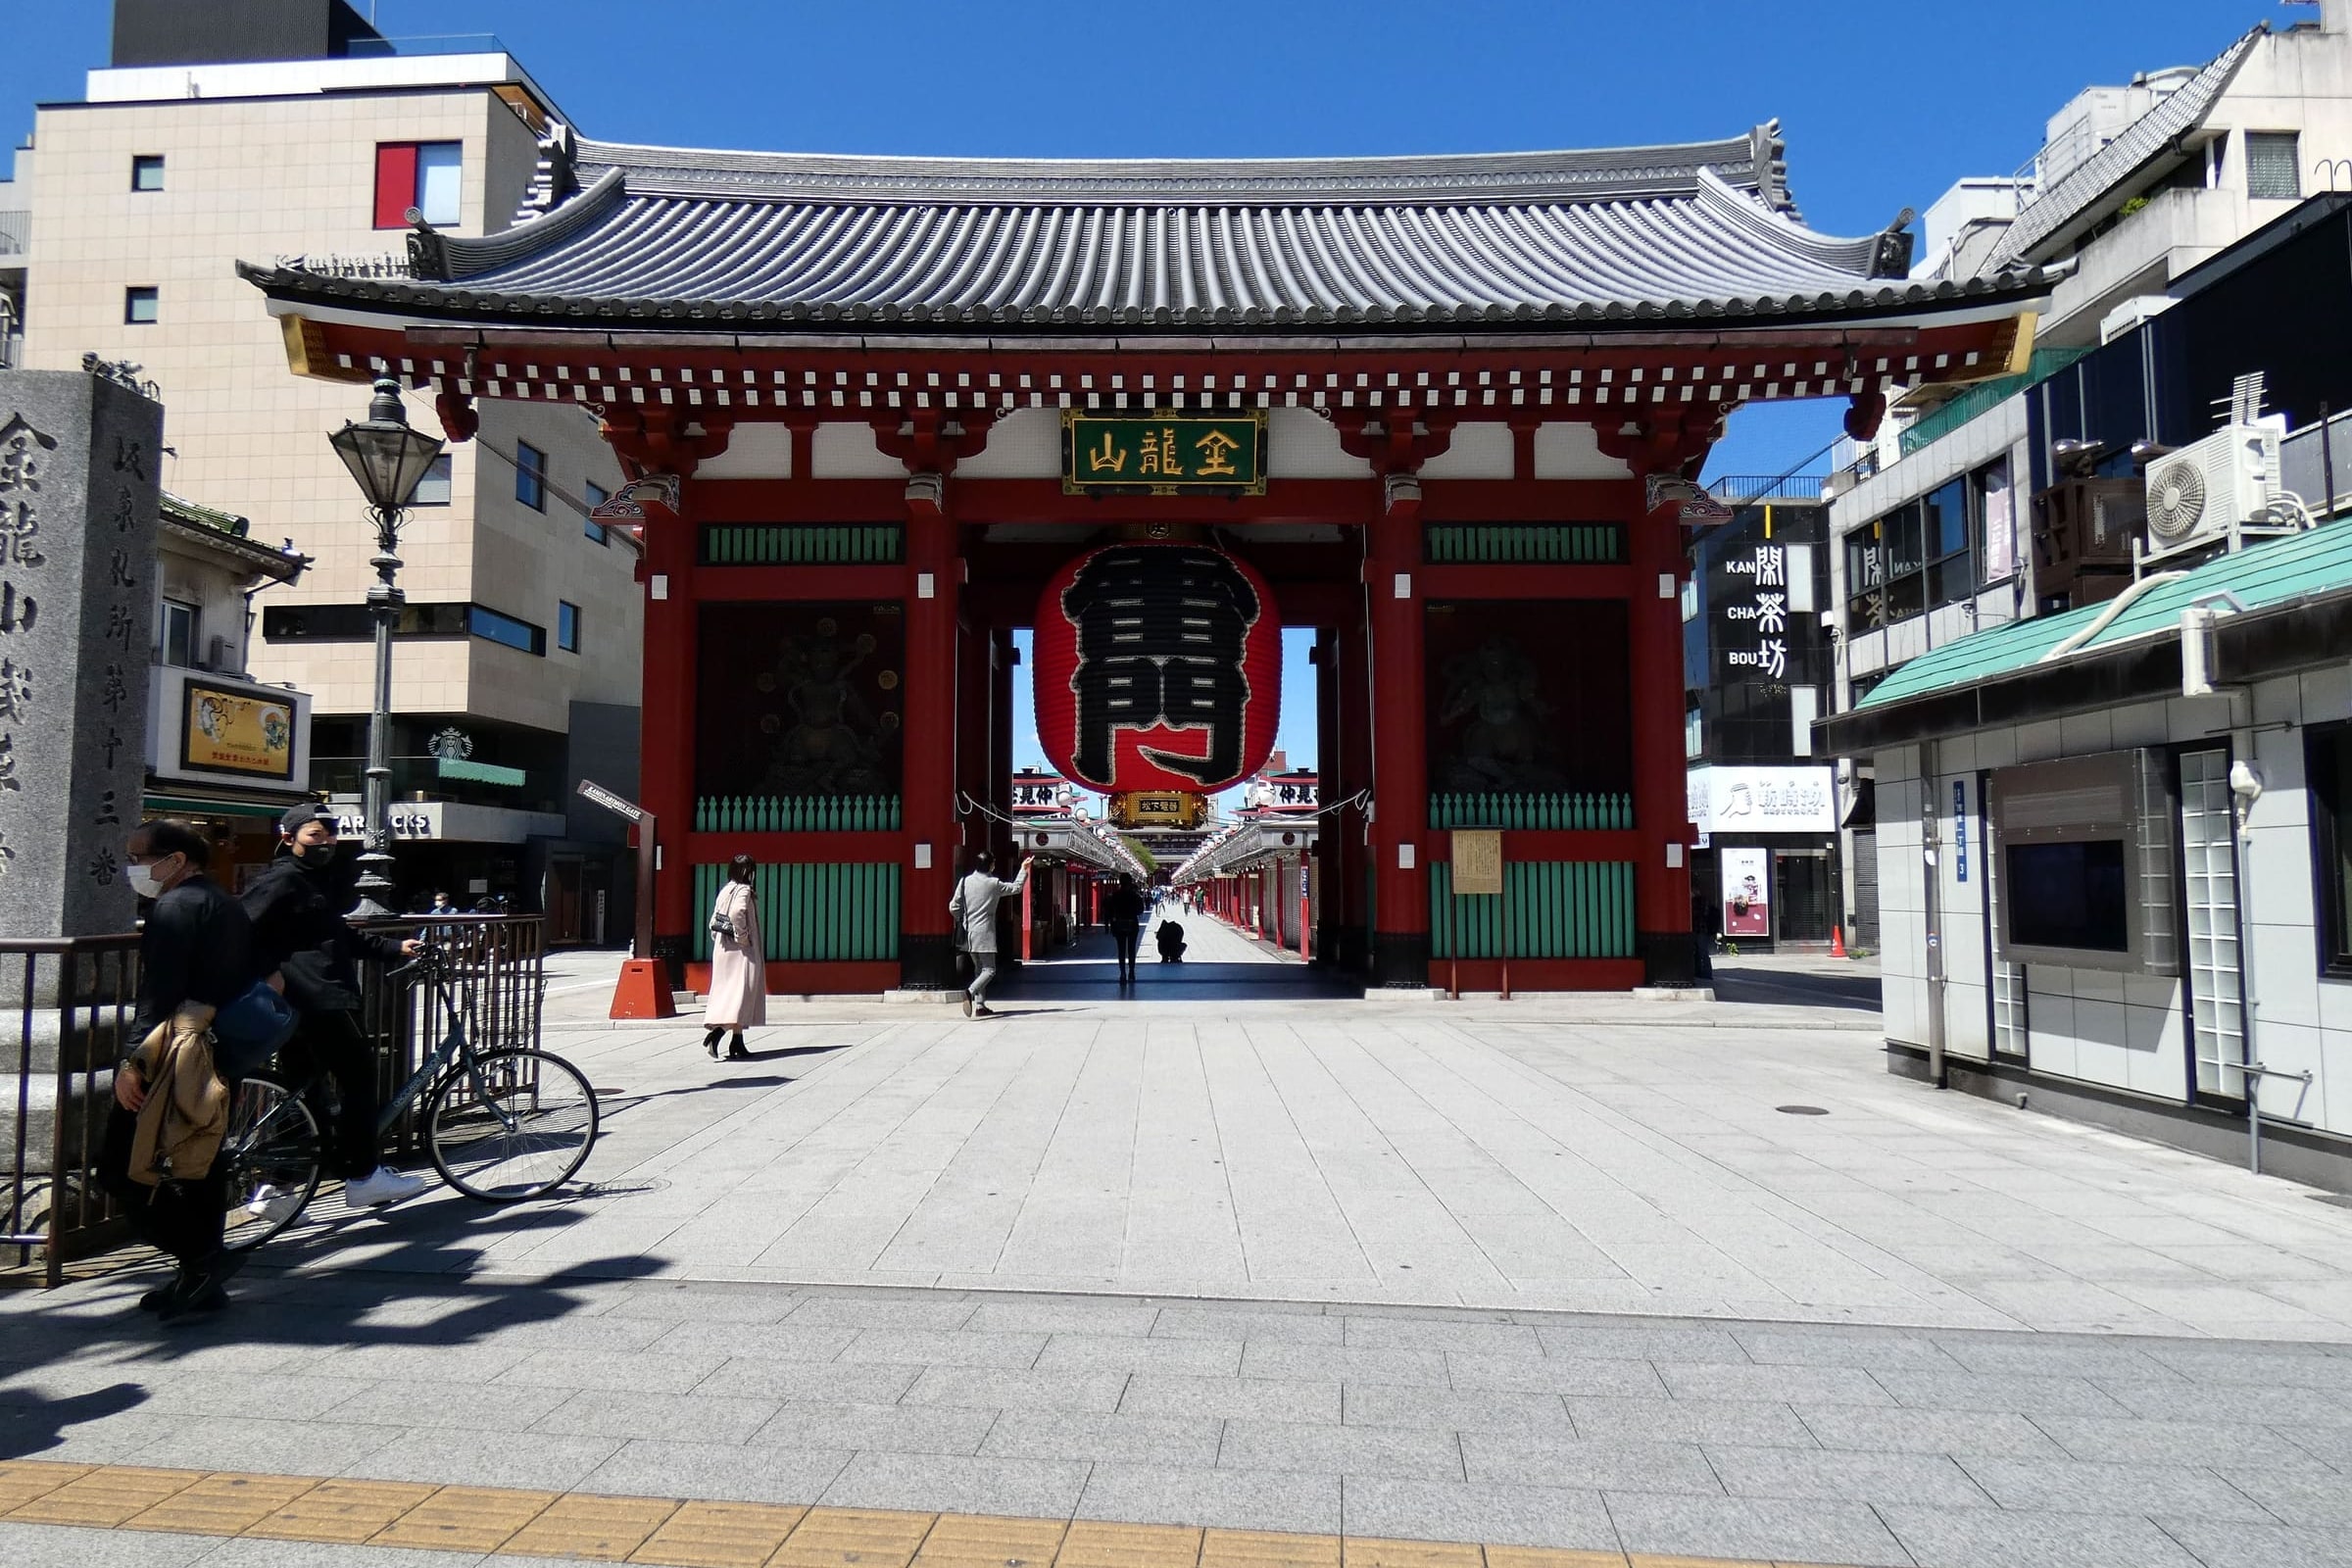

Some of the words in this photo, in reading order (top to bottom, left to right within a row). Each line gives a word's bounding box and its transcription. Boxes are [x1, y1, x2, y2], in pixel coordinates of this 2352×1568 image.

[1090, 427, 1240, 475] 金龍山
[1726, 561, 1756, 574] KAN
[1727, 607, 1757, 619] CHA
[1729, 652, 1758, 665] BOU
[1060, 545, 1261, 786] 雷門
[1959, 863, 1965, 874] 3
